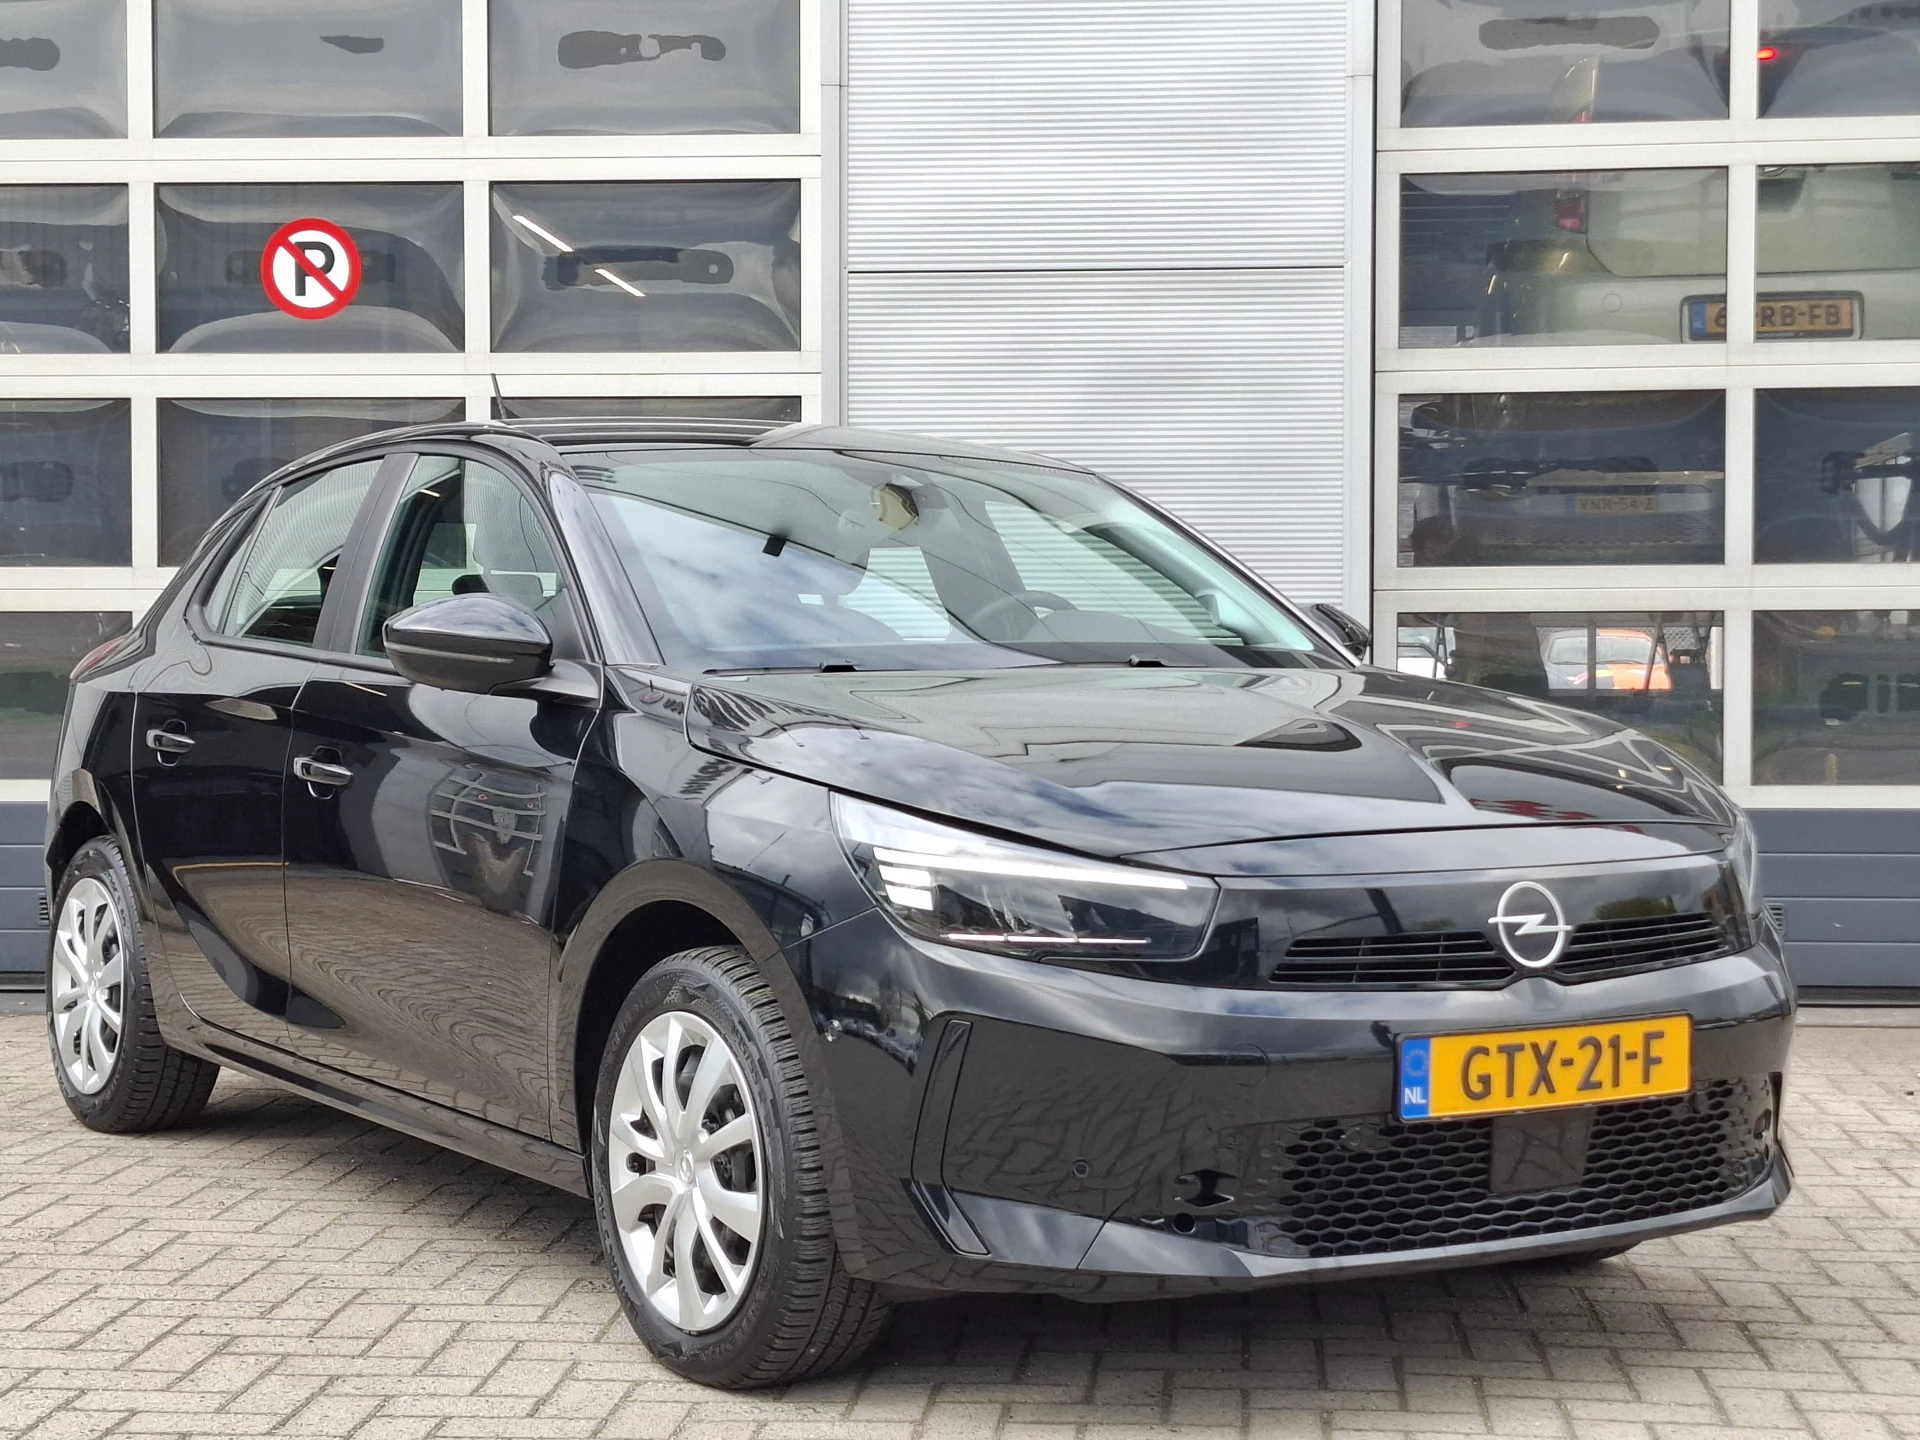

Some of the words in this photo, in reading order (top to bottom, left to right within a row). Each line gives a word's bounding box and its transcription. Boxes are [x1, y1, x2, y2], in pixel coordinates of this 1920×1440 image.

[294, 241, 335, 296] P
[1460, 1030, 1665, 1101] GTX-21-F
[1403, 1086, 1427, 1105] NL
